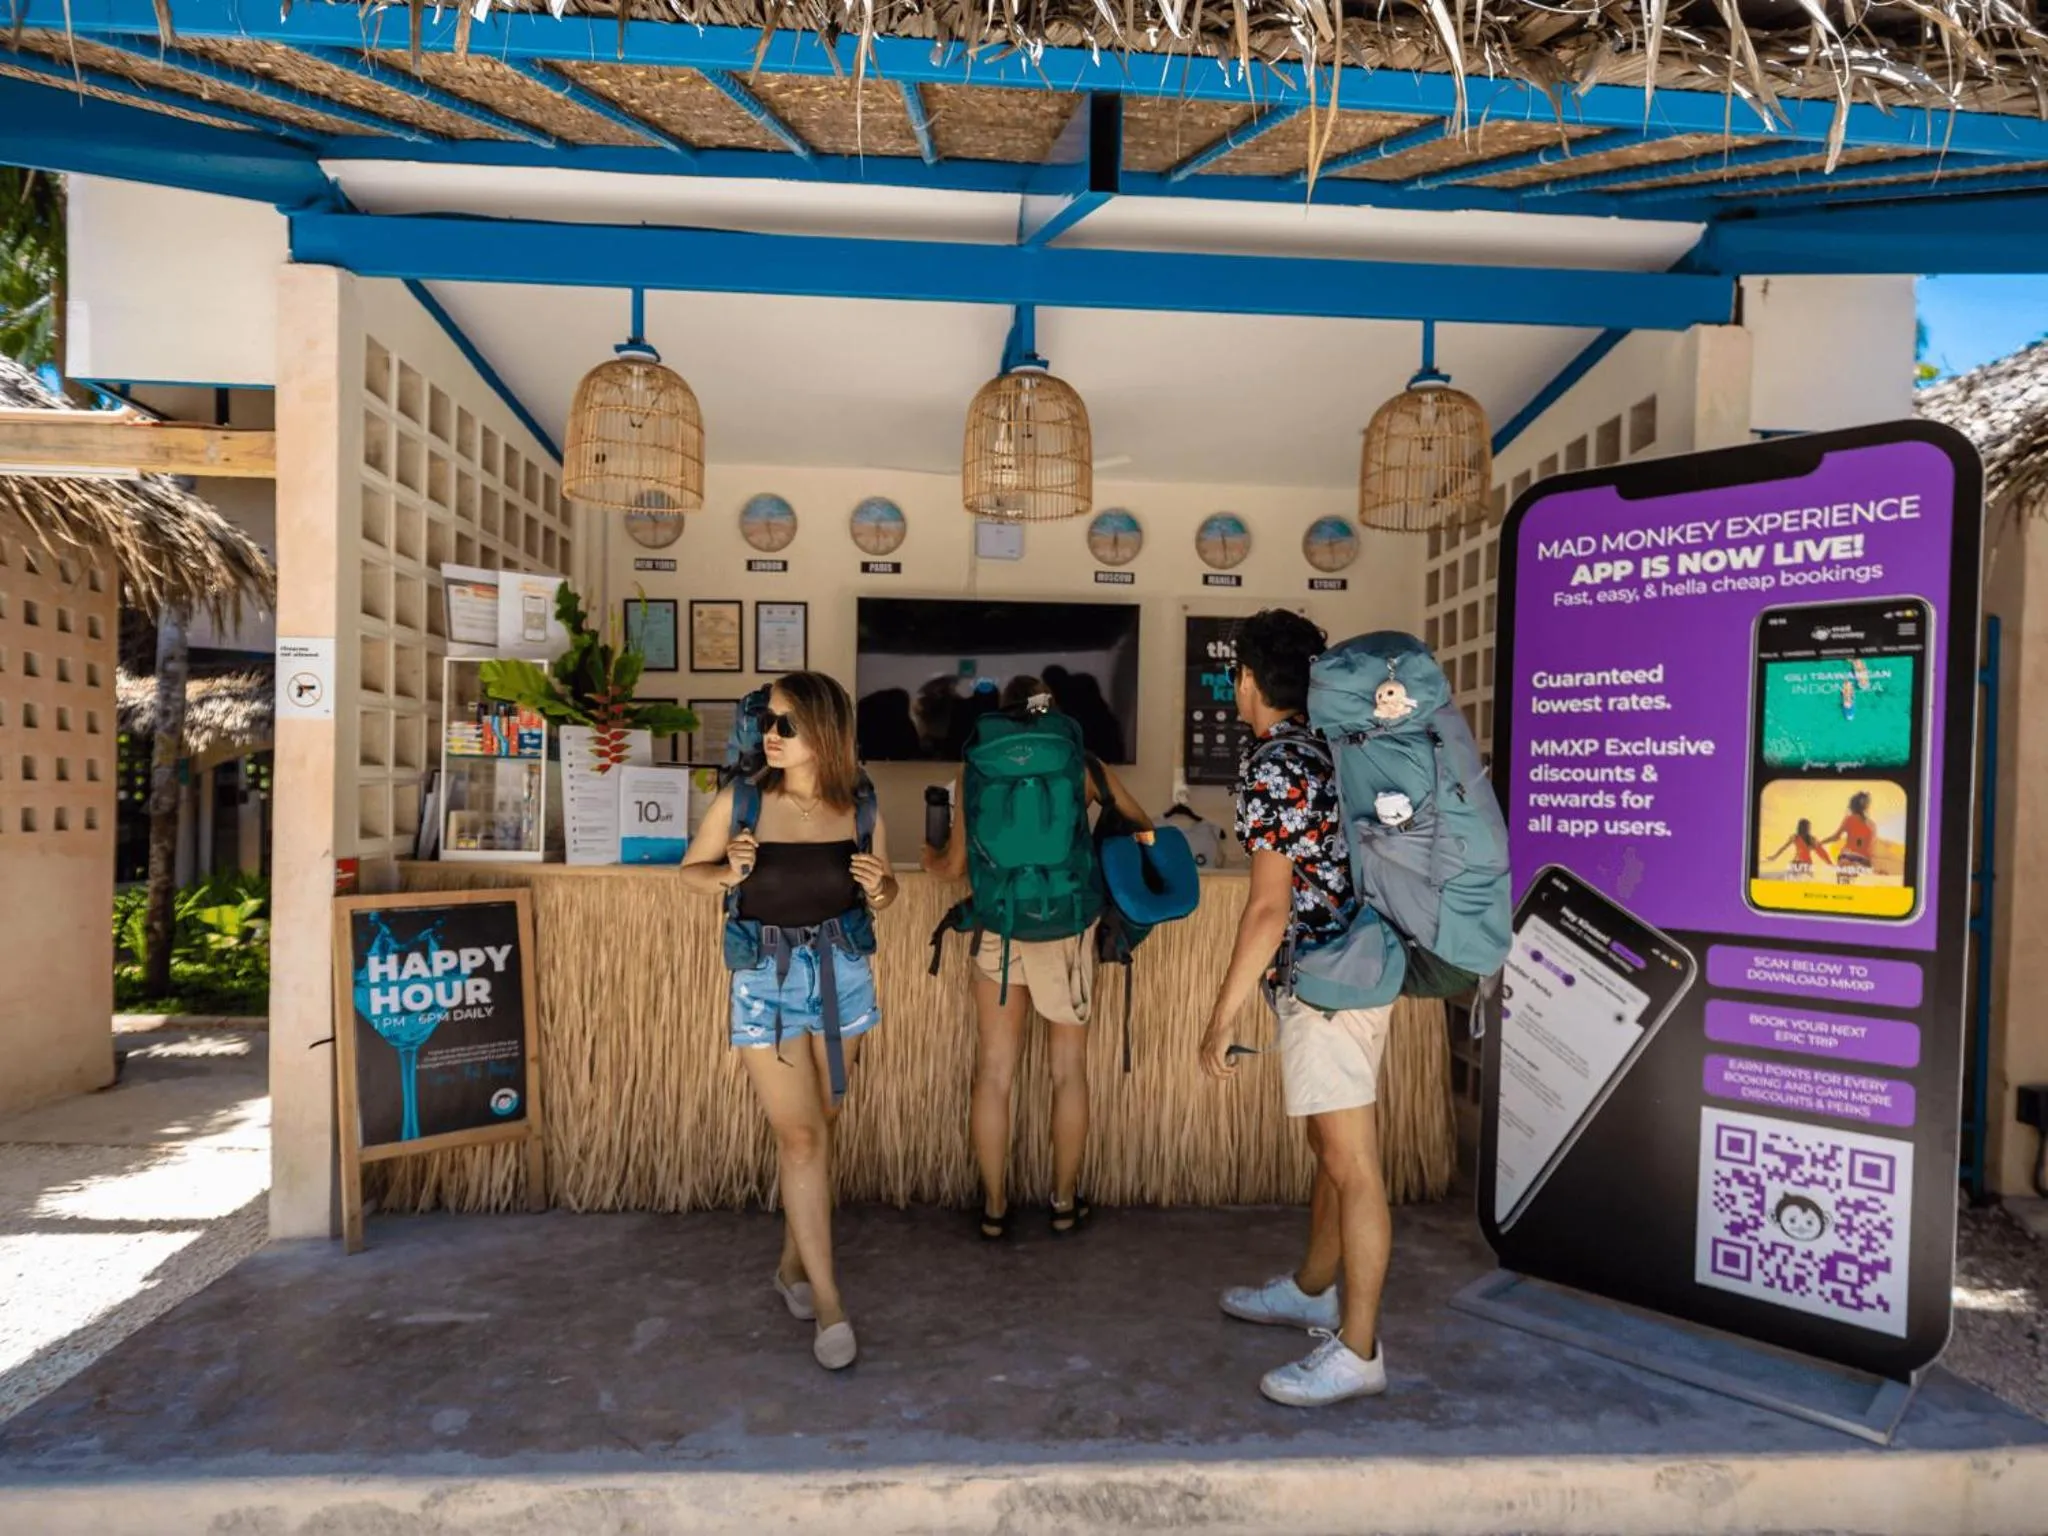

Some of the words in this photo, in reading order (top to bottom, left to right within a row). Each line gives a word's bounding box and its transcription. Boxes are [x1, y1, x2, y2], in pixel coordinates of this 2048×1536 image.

[1538, 535, 1596, 562] MAD
[1602, 519, 1721, 553] MONKEY
[1726, 495, 1921, 540] EXPERIENCE
[1571, 558, 1634, 586] APP
[1641, 554, 1670, 579] IS
[1677, 545, 1764, 575] NOW
[1773, 533, 1865, 567] LIVE!
[1553, 589, 1594, 608] Fast,
[1597, 586, 1640, 608] easy,
[1643, 583, 1658, 600] &
[1661, 578, 1707, 598] hella
[1712, 574, 1776, 597] cheap
[1780, 562, 1883, 588] bookings
[1532, 665, 1664, 689] Guaranteed
[1531, 695, 1602, 716] lowest
[1607, 692, 1672, 712] rates.
[1530, 738, 1599, 757] MMXP
[1605, 736, 1715, 757] Exclusive
[1529, 764, 1636, 783] discounts
[1640, 764, 1658, 783] &
[1529, 790, 1616, 809] rewards
[1621, 789, 1655, 809] for
[634, 800, 660, 823] 10
[1528, 814, 1552, 834] all
[1557, 818, 1598, 840] app
[1604, 819, 1672, 837] users.
[367, 944, 513, 983] HAPPY
[1753, 955, 1789, 971] SCAN
[1792, 960, 1842, 975] BELOW
[1849, 965, 1868, 978] TO
[1747, 969, 1828, 988] DOWNLOAD
[1831, 978, 1875, 992] MMXP
[370, 977, 492, 1016] HOUR
[453, 1006, 495, 1022] DAILY
[1750, 1013, 1789, 1029] BOOK
[1792, 1018, 1829, 1034] YOUR
[1831, 1024, 1868, 1039] NEXT
[1775, 1029, 1805, 1044] EPIC
[1809, 1034, 1839, 1049] TRIP
[1728, 1059, 1764, 1074] EARN
[1766, 1064, 1812, 1082] POINTS
[1814, 1071, 1841, 1085] FOR
[1843, 1076, 1889, 1093] EVERY
[1724, 1071, 1782, 1090] BOOKING
[1785, 1080, 1813, 1095] AND
[1815, 1085, 1848, 1100] GAIN
[1850, 1092, 1893, 1108] MORE
[1741, 1087, 1814, 1108] DISCOUNTS
